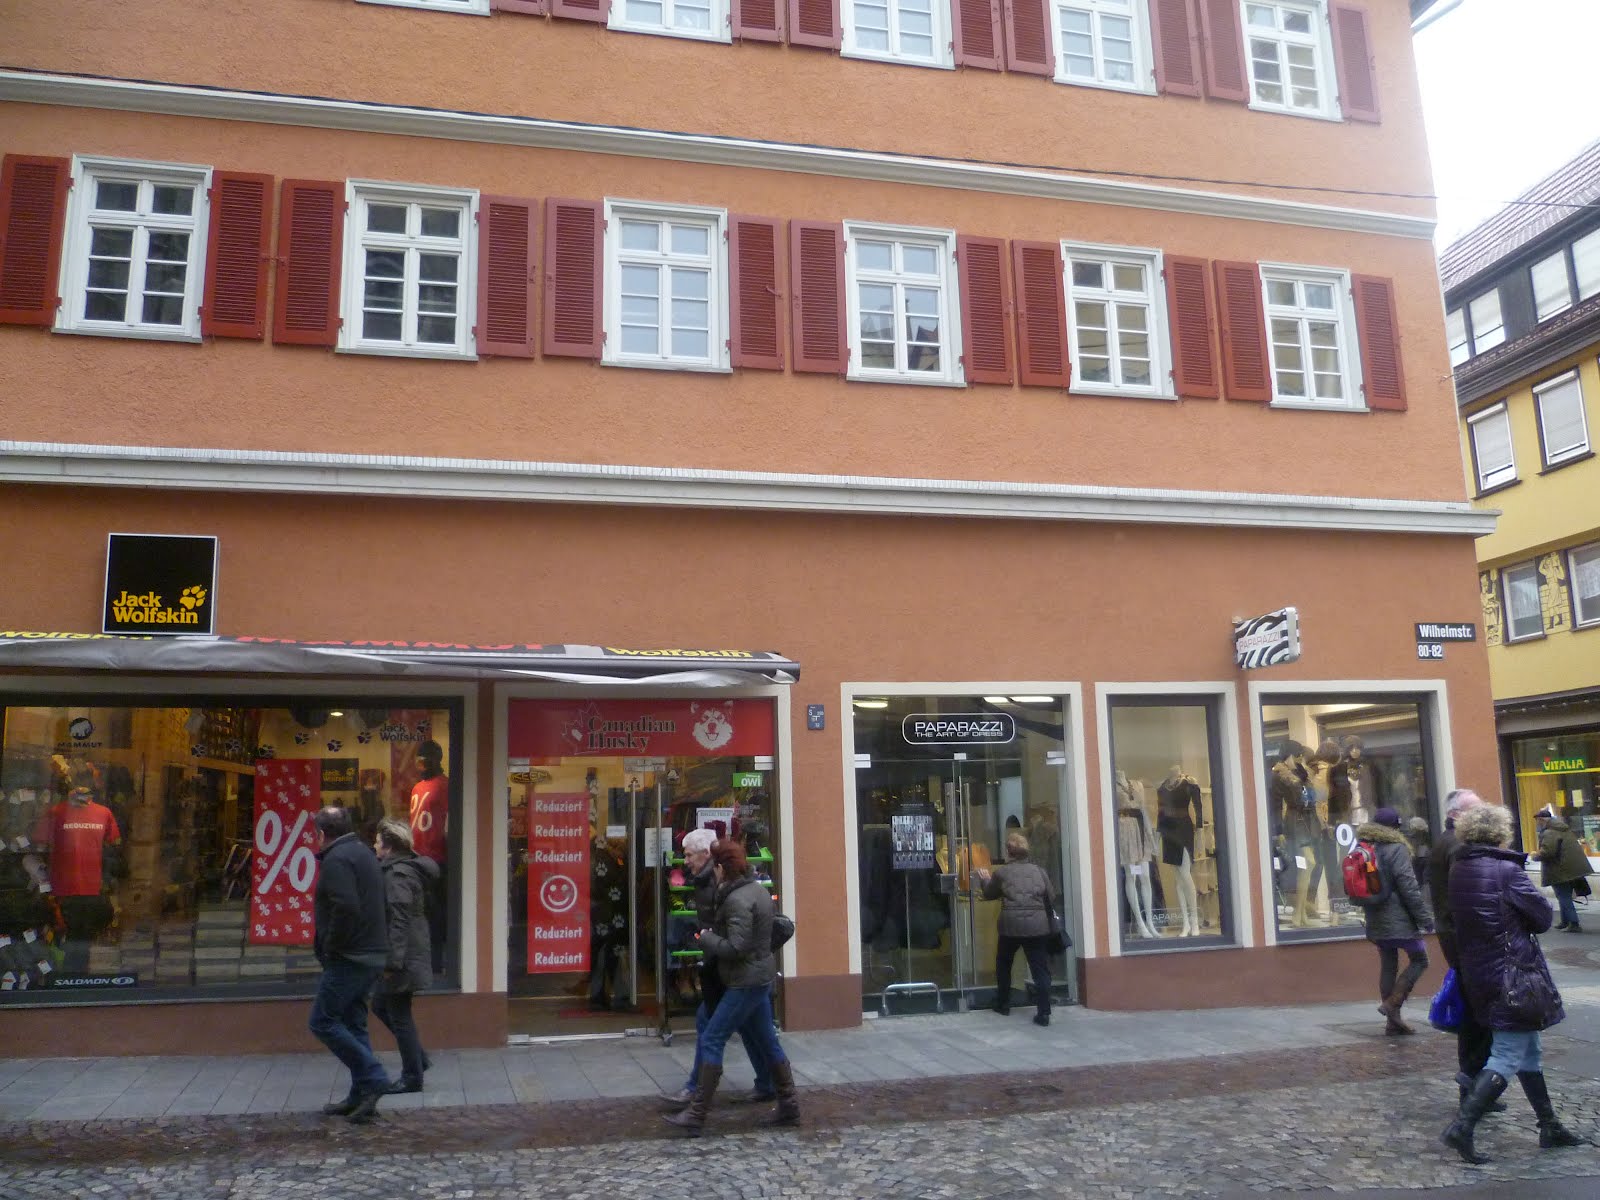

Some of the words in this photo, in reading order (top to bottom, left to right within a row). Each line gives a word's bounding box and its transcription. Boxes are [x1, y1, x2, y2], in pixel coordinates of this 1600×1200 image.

[113, 590, 162, 607] Jack
[112, 606, 199, 624] Wolfskin
[1418, 624, 1472, 638] Wilhelmstr.
[1239, 631, 1280, 649] PAPARAZZI
[1418, 644, 1443, 657] 80-82
[381, 722, 406, 733] Jack
[587, 715, 677, 733] Canadian
[914, 721, 1003, 732] PAPARAZZI
[380, 731, 427, 742] Wolfskin
[587, 732, 649, 753] Husky
[1543, 758, 1585, 771] VITALIA
[535, 799, 583, 813] Reduziert
[63, 822, 104, 830] REDUZIERT
[535, 824, 583, 838] Reduziert
[535, 849, 583, 863] Reduziert
[535, 926, 583, 940] Reduziert
[535, 951, 583, 965] Reduziert
[54, 977, 110, 986] SALOMON
